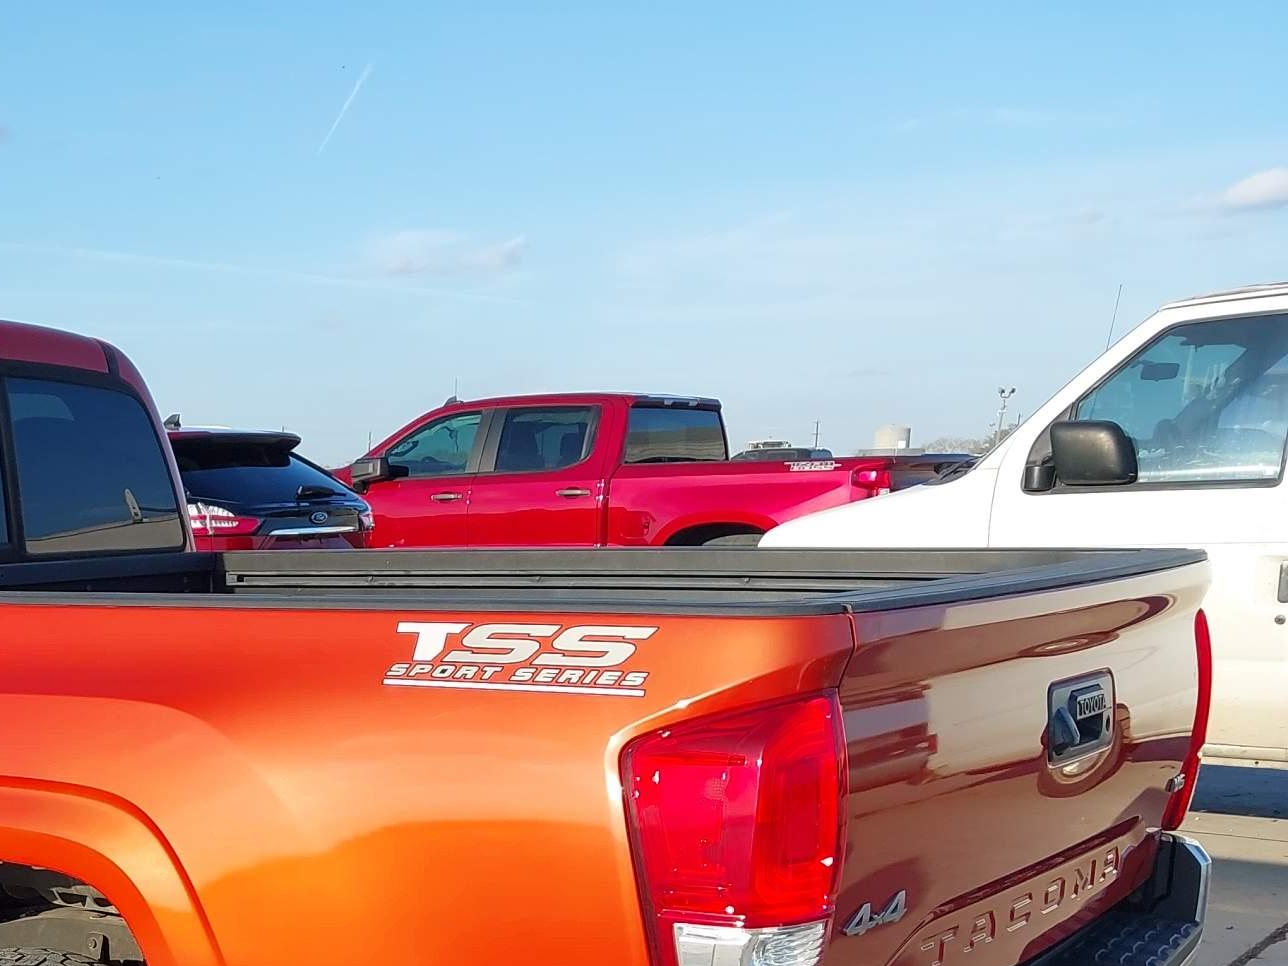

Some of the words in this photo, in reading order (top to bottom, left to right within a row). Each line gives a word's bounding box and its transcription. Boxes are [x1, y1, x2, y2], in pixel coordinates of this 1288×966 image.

[396, 620, 660, 667] TSS
[384, 662, 504, 681] SPORT
[508, 666, 650, 688] SERIES
